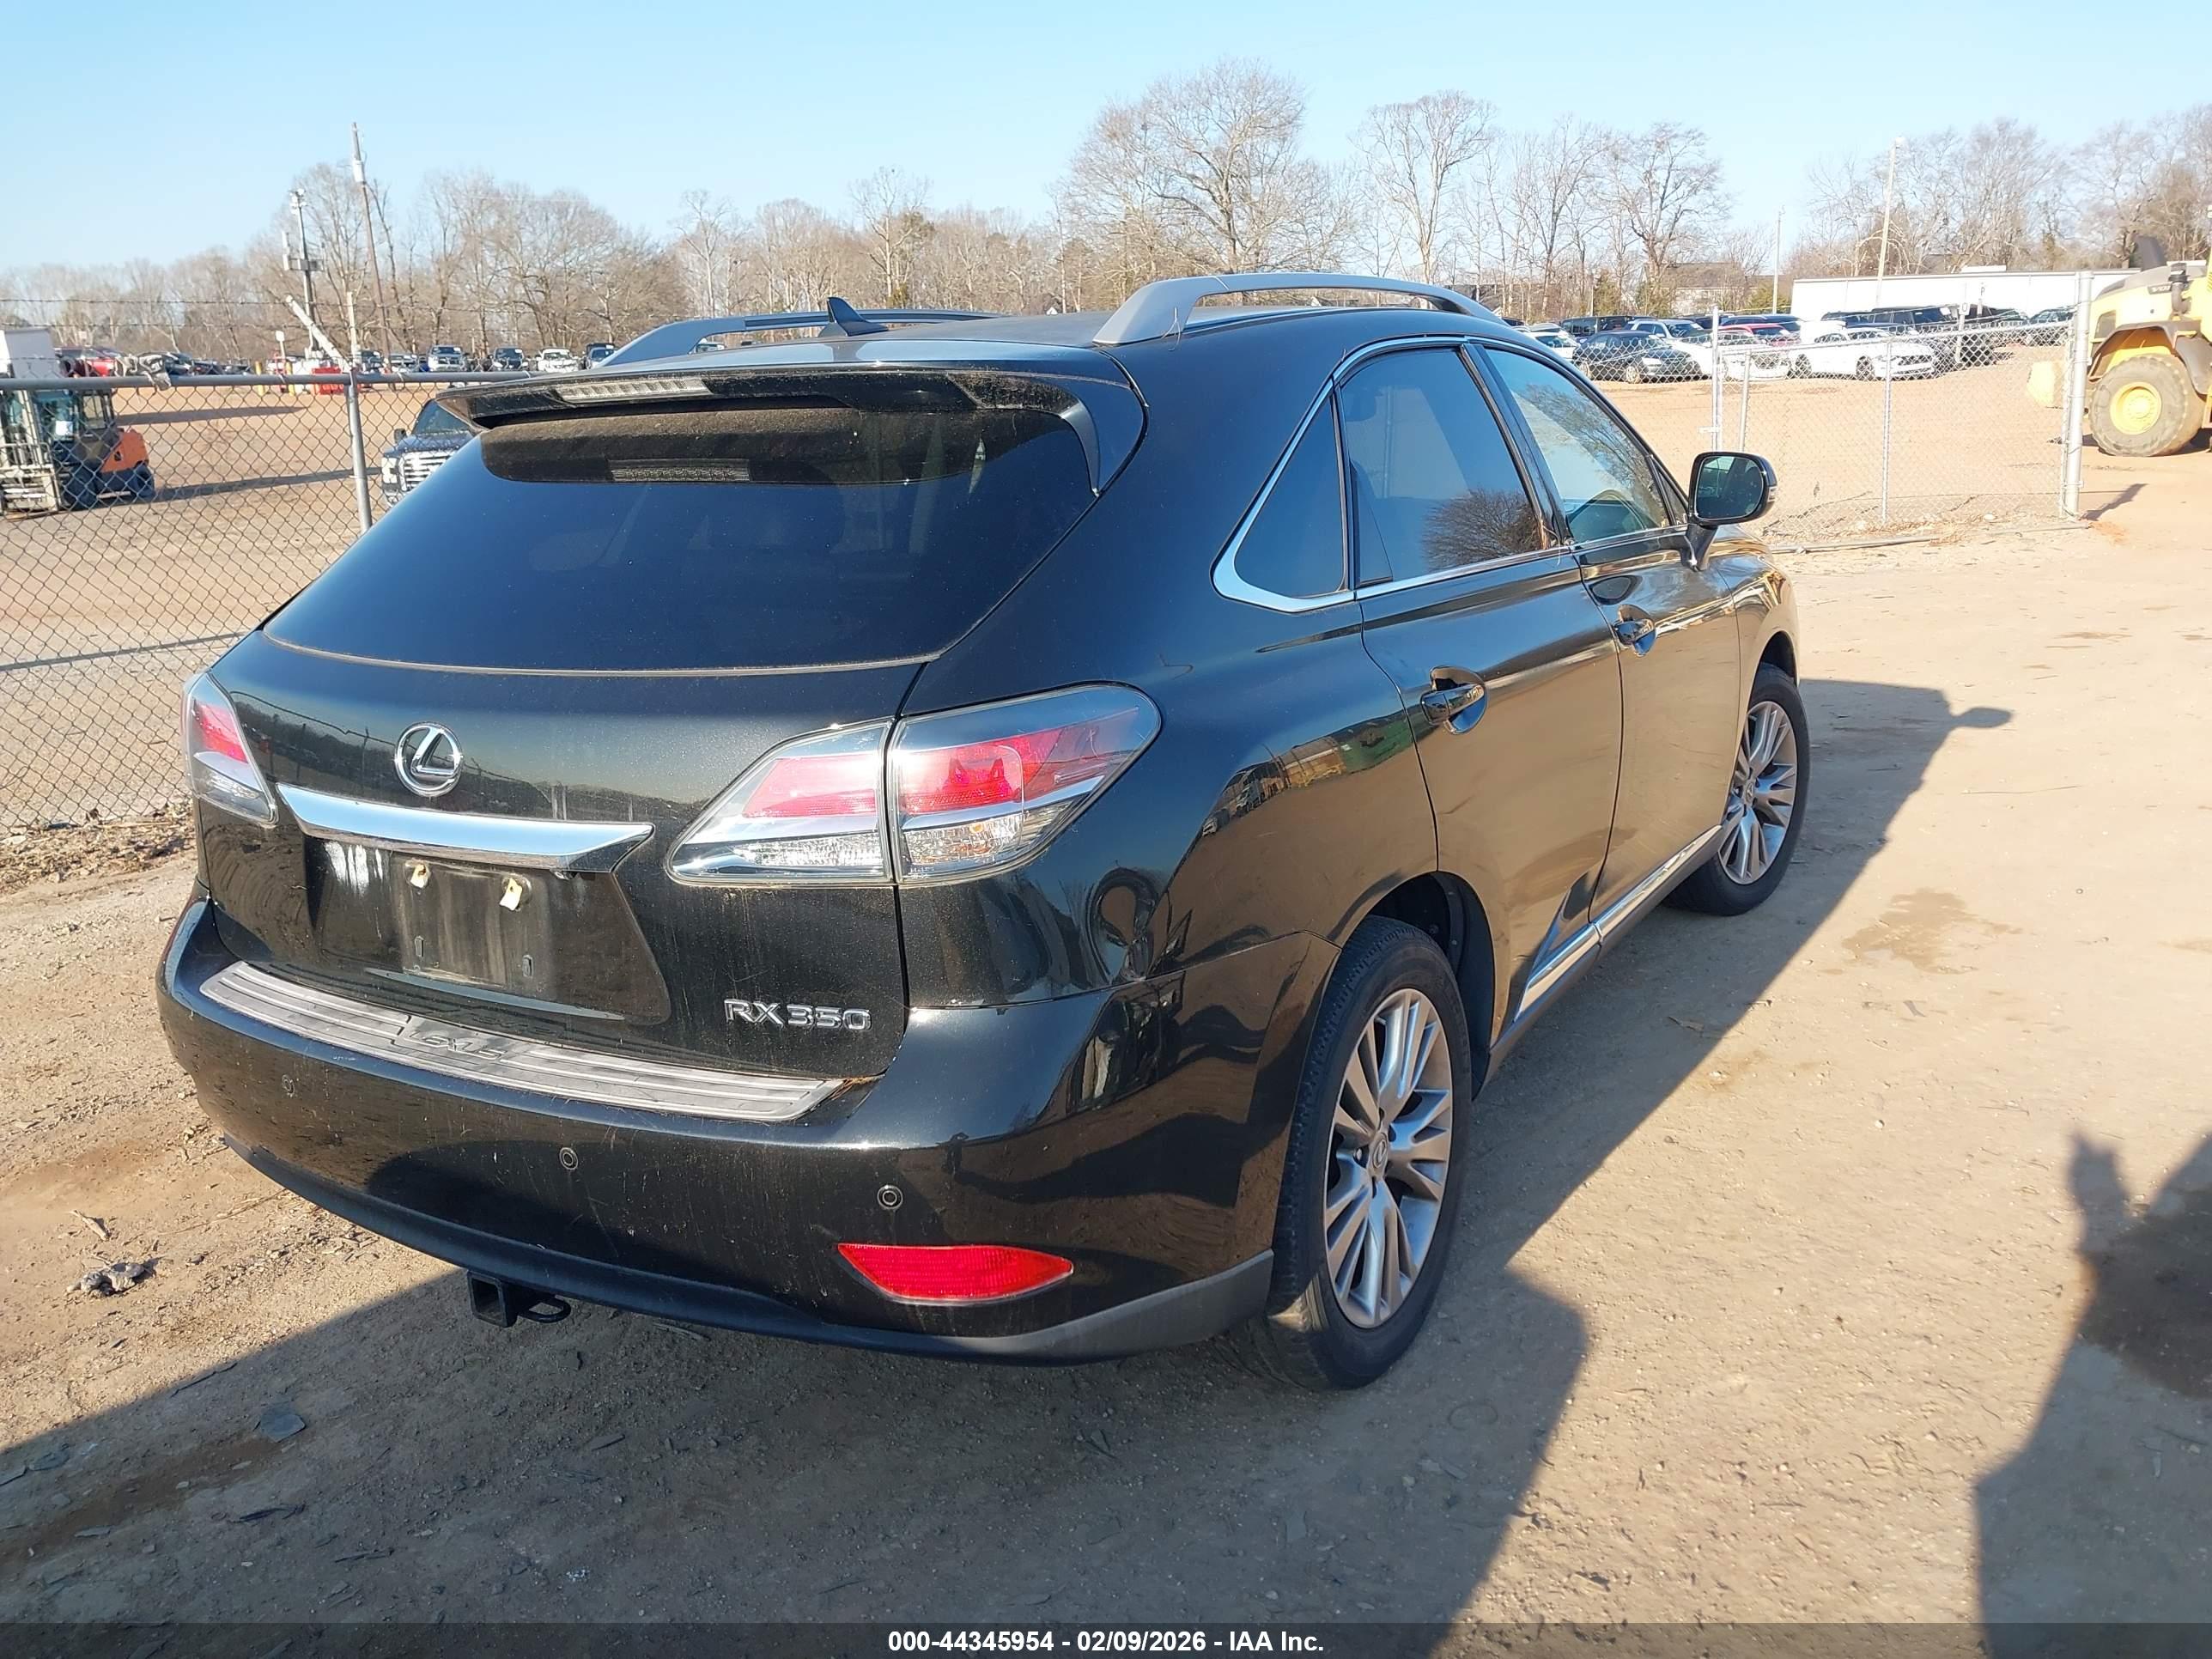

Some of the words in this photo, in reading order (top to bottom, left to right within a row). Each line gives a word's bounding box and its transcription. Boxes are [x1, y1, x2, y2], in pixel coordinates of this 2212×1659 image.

[724, 998, 785, 1029] RX
[787, 1003, 872, 1031] 350
[404, 1030, 508, 1061] LEXUS
